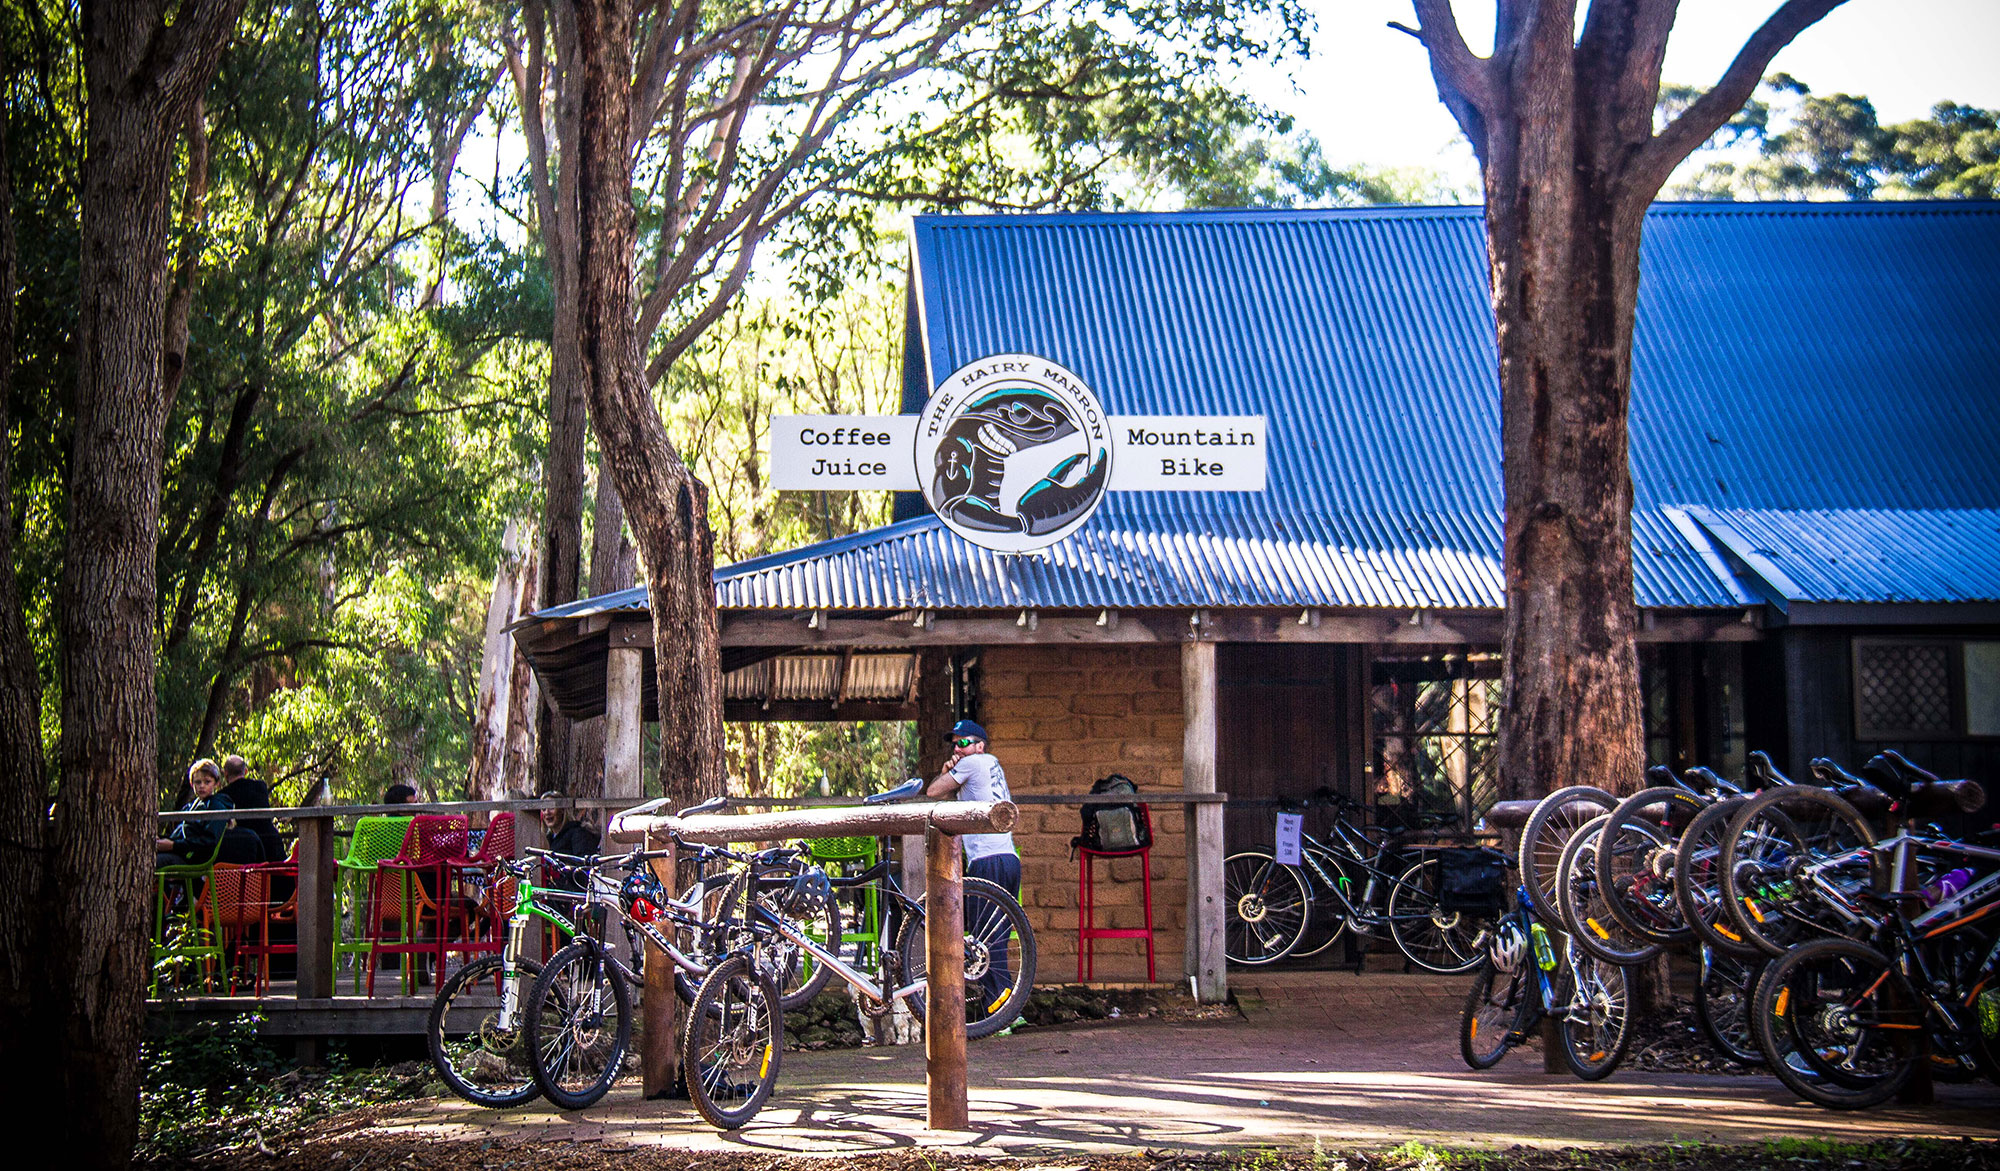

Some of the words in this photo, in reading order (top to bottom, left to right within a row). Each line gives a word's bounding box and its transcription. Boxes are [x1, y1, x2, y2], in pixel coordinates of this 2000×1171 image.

[928, 393, 954, 438] THE
[961, 363, 1030, 387] HAIRY
[1044, 368, 1103, 440] MARRON
[800, 428, 891, 446] Coffee
[1127, 428, 1256, 446] Mountain
[811, 458, 887, 476] Juice
[1160, 458, 1224, 476] Bike
[606, 1048, 626, 1086] MAXXIS
